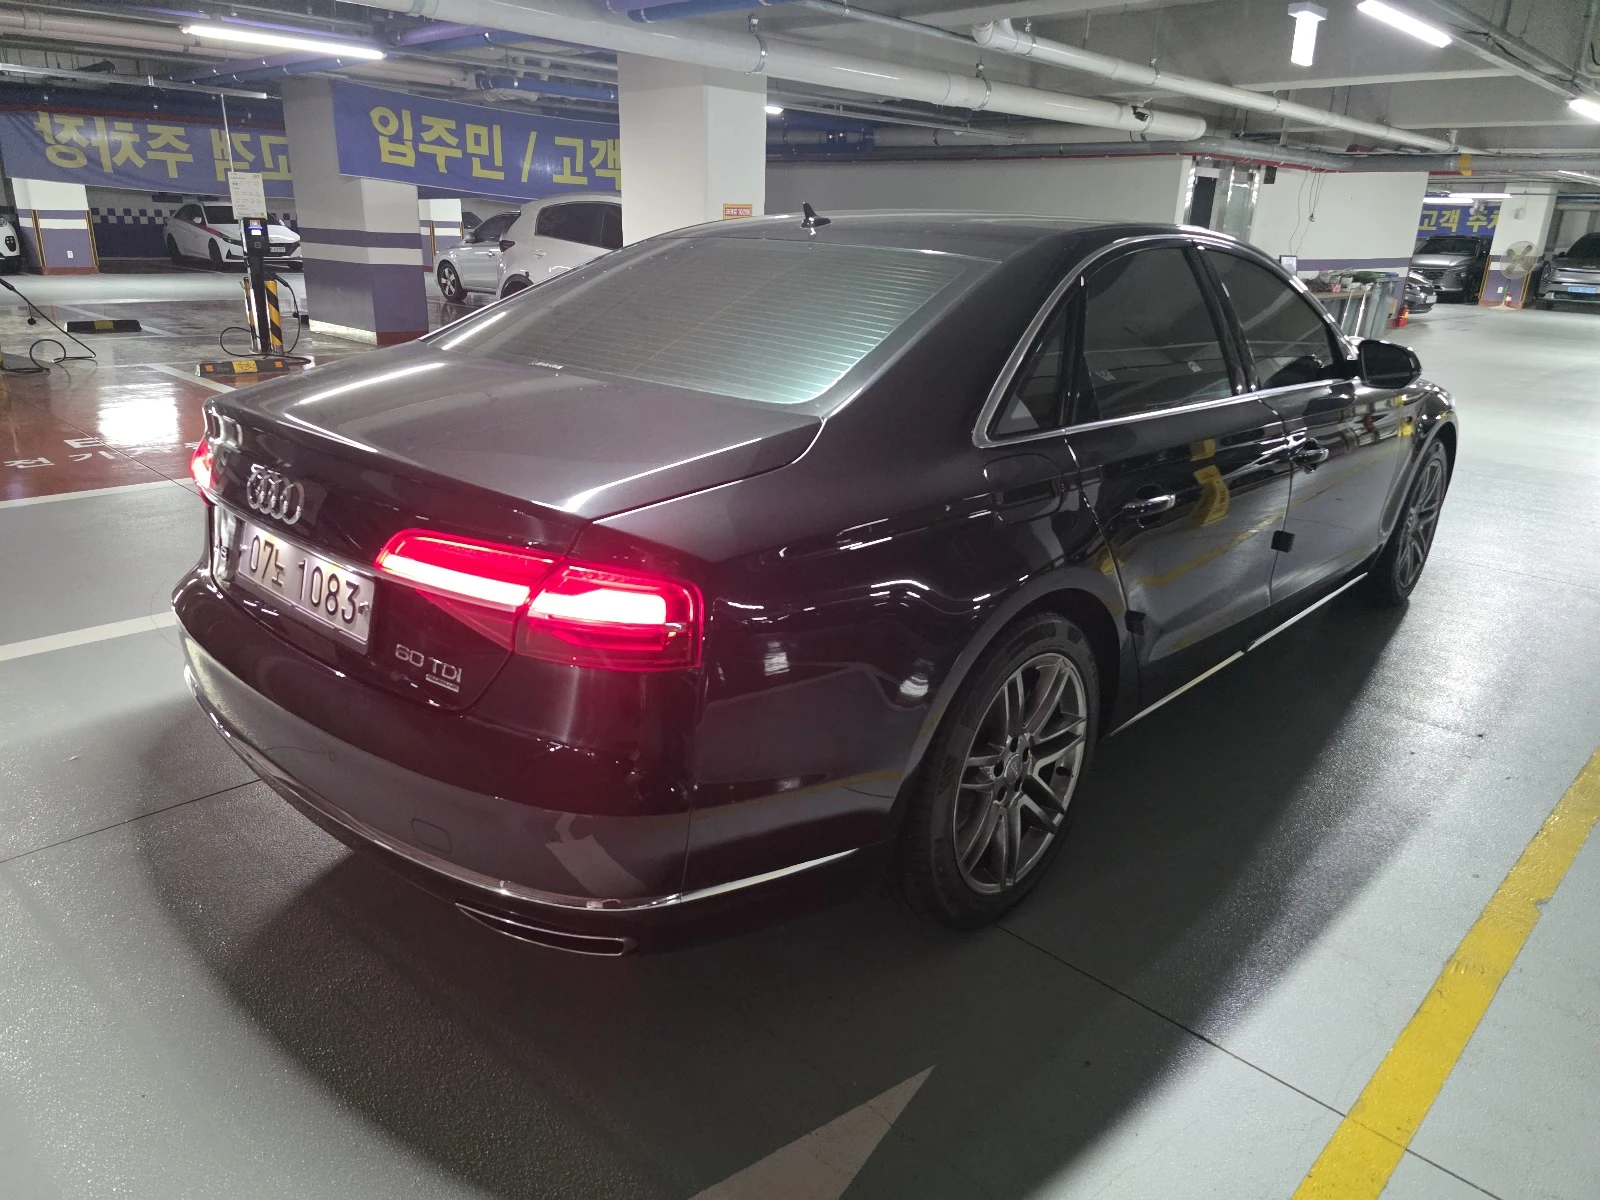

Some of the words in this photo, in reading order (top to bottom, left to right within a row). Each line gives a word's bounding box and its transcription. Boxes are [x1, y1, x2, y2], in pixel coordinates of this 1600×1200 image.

[370, 106, 505, 180] 입주민
[521, 131, 537, 183] /
[553, 136, 622, 191] 고객
[1418, 209, 1460, 233] 고객
[249, 534, 286, 588] 07노
[298, 557, 360, 624] 1083
[394, 643, 425, 668] 60
[428, 656, 462, 684] TDI
